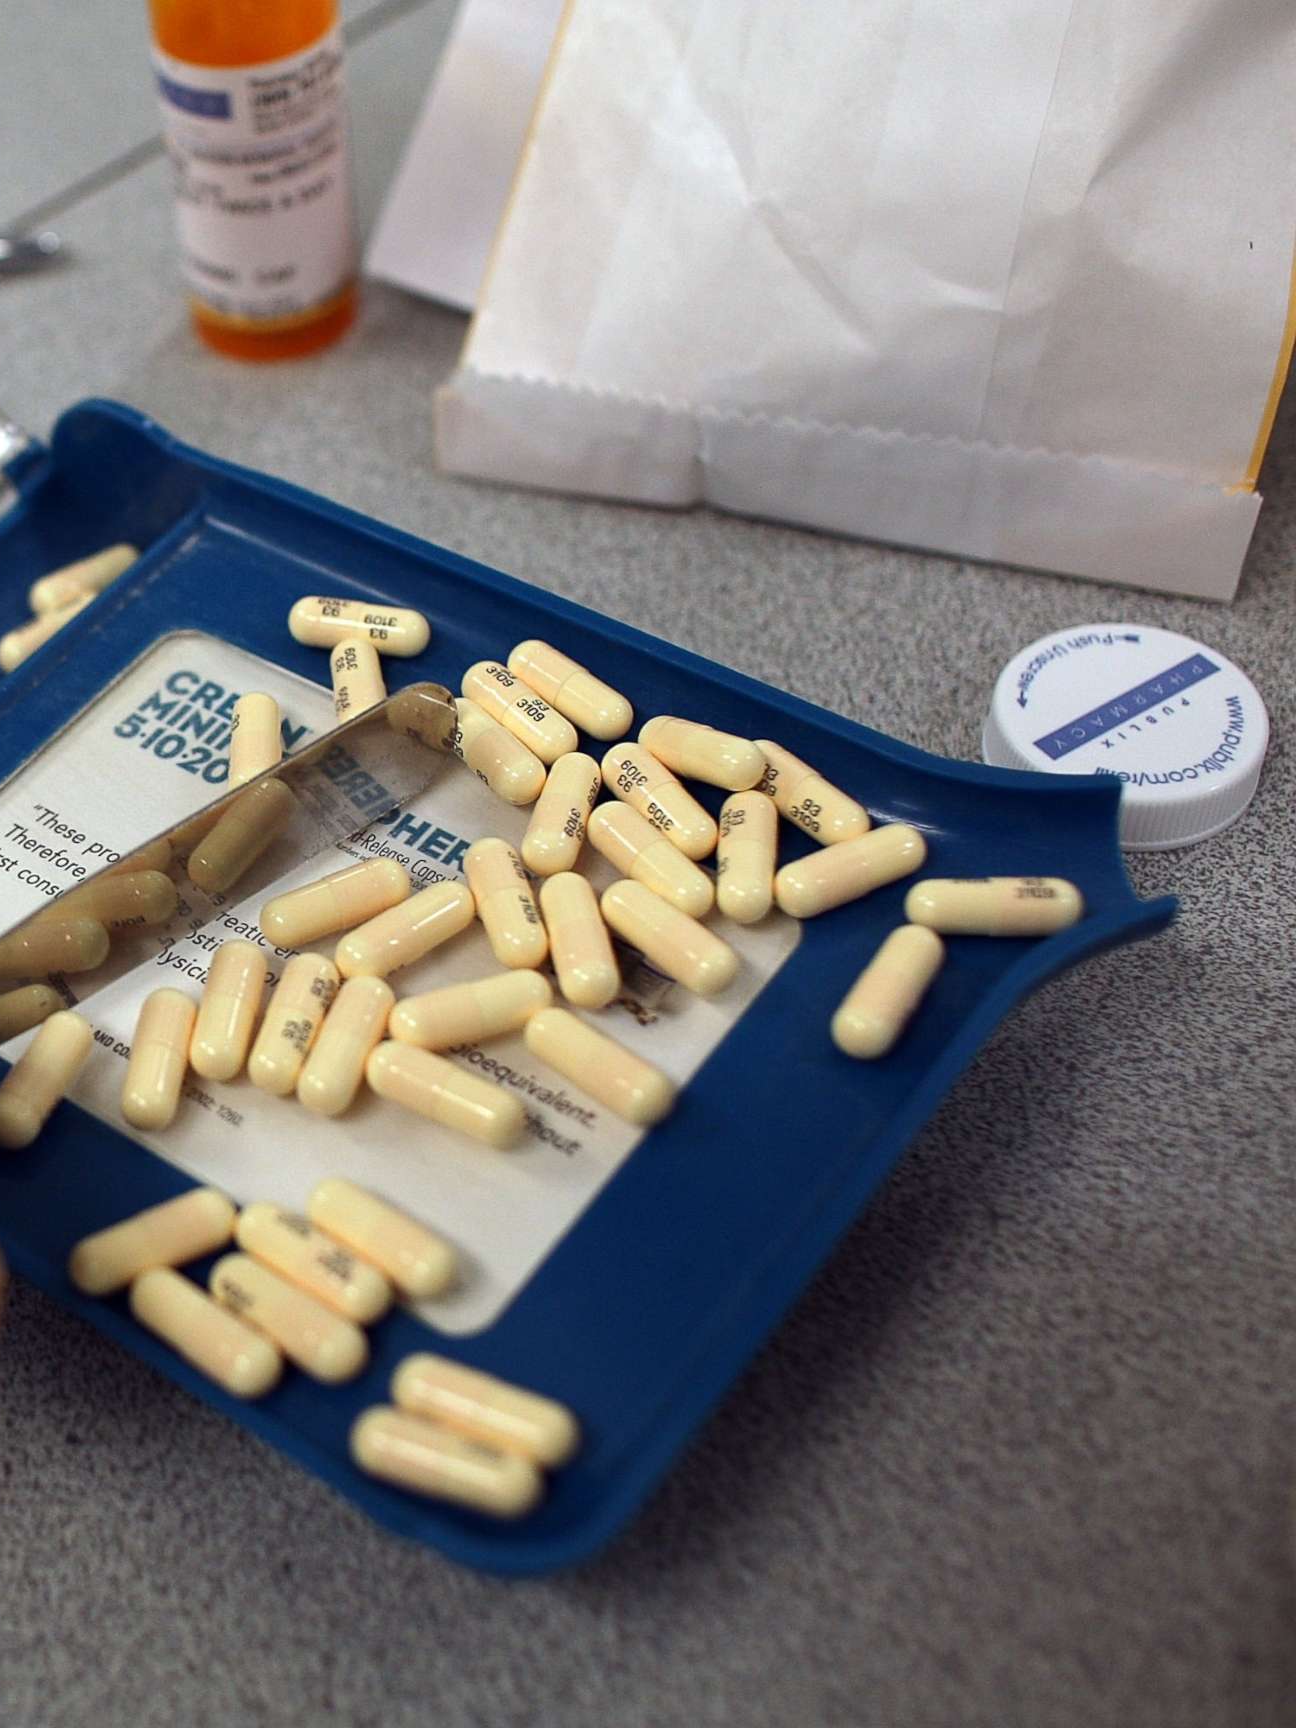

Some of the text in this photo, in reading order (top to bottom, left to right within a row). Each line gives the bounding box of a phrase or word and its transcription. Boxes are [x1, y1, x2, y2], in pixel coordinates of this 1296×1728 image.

[364, 615, 398, 627] 3109
[369, 628, 388, 640] 93
[486, 666, 514, 687] 3109
[166, 670, 306, 750] CREN
[516, 699, 545, 722] 3109
[1054, 664, 1205, 751] PHARMACY
[1102, 698, 1191, 750] PUBLIX
[617, 774, 633, 793] 93
[620, 760, 648, 787] 3109
[647, 802, 674, 831] 3109
[789, 806, 821, 833] 3109
[802, 798, 822, 817] 93
[564, 808, 581, 837] 3109
